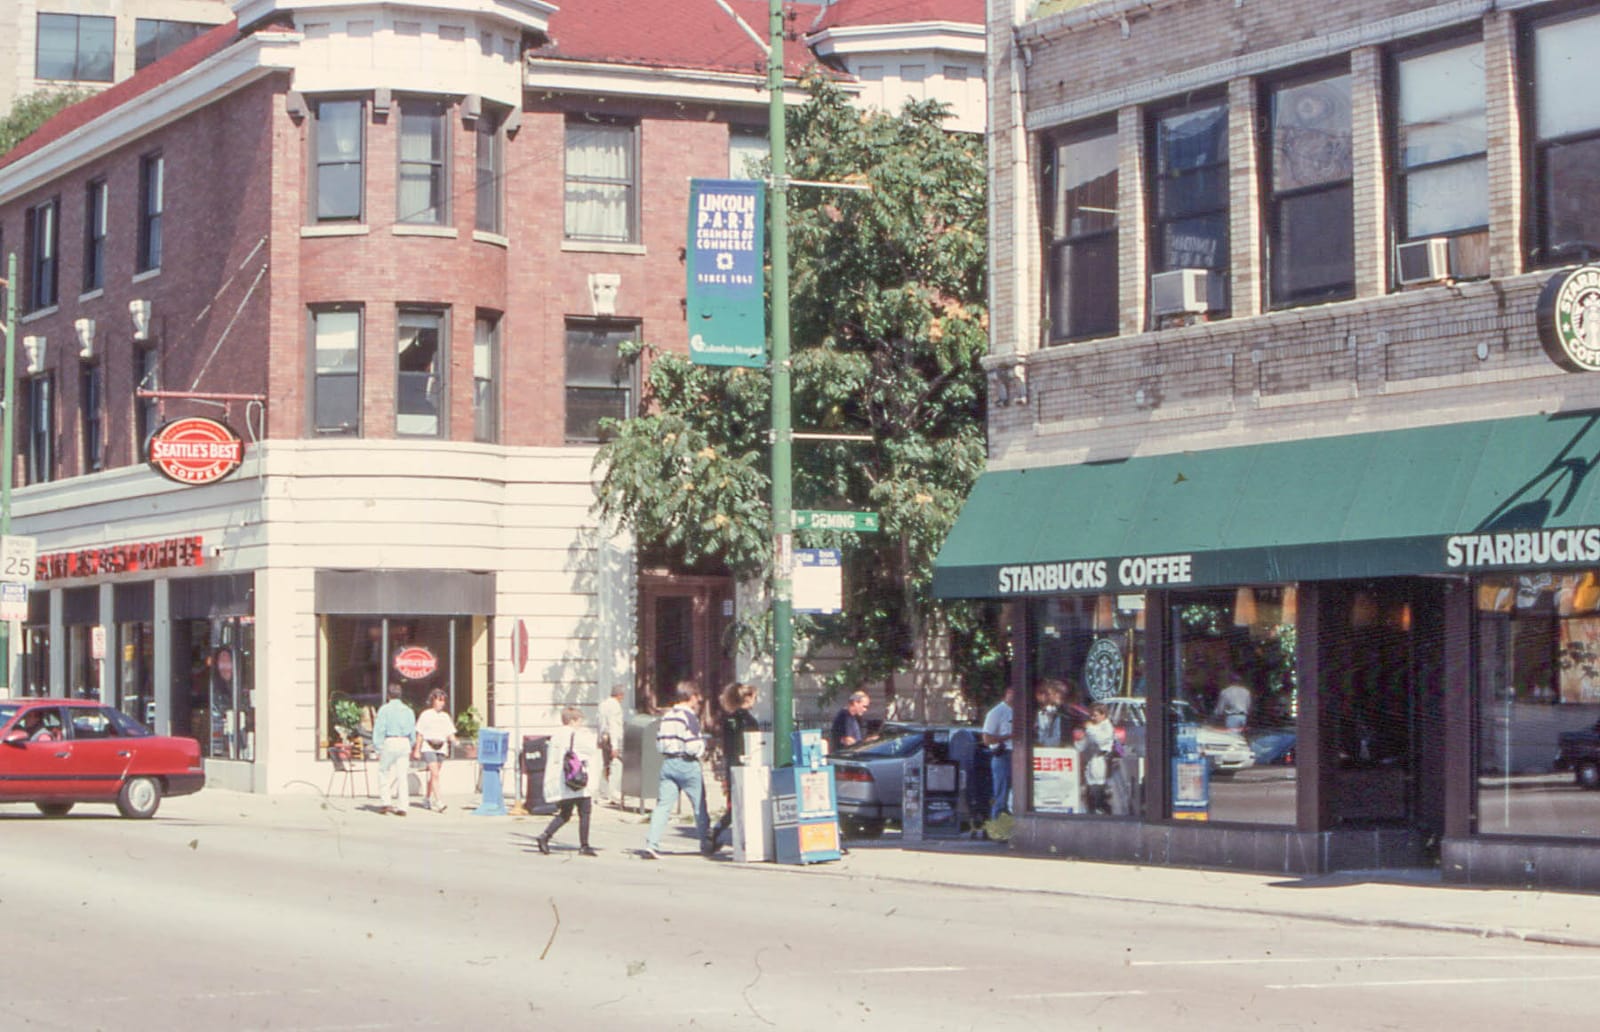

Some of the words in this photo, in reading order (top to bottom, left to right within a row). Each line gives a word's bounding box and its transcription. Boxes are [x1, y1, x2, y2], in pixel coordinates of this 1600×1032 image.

[699, 194, 754, 212] LINCOLN
[697, 229, 739, 239] CHAMBER
[741, 231, 754, 240] OF
[697, 239, 753, 250] COMMERCE
[1561, 271, 1600, 314] STARB
[153, 440, 209, 458] SEATTLE'S
[210, 443, 239, 460] BEST
[169, 464, 223, 479] COFFEE
[811, 513, 855, 529] DEMING
[1446, 527, 1600, 568] STARBUCKS
[5, 557, 31, 576] 25
[999, 560, 1107, 592] STARBUCKS
[1118, 554, 1193, 587] COFFEE
